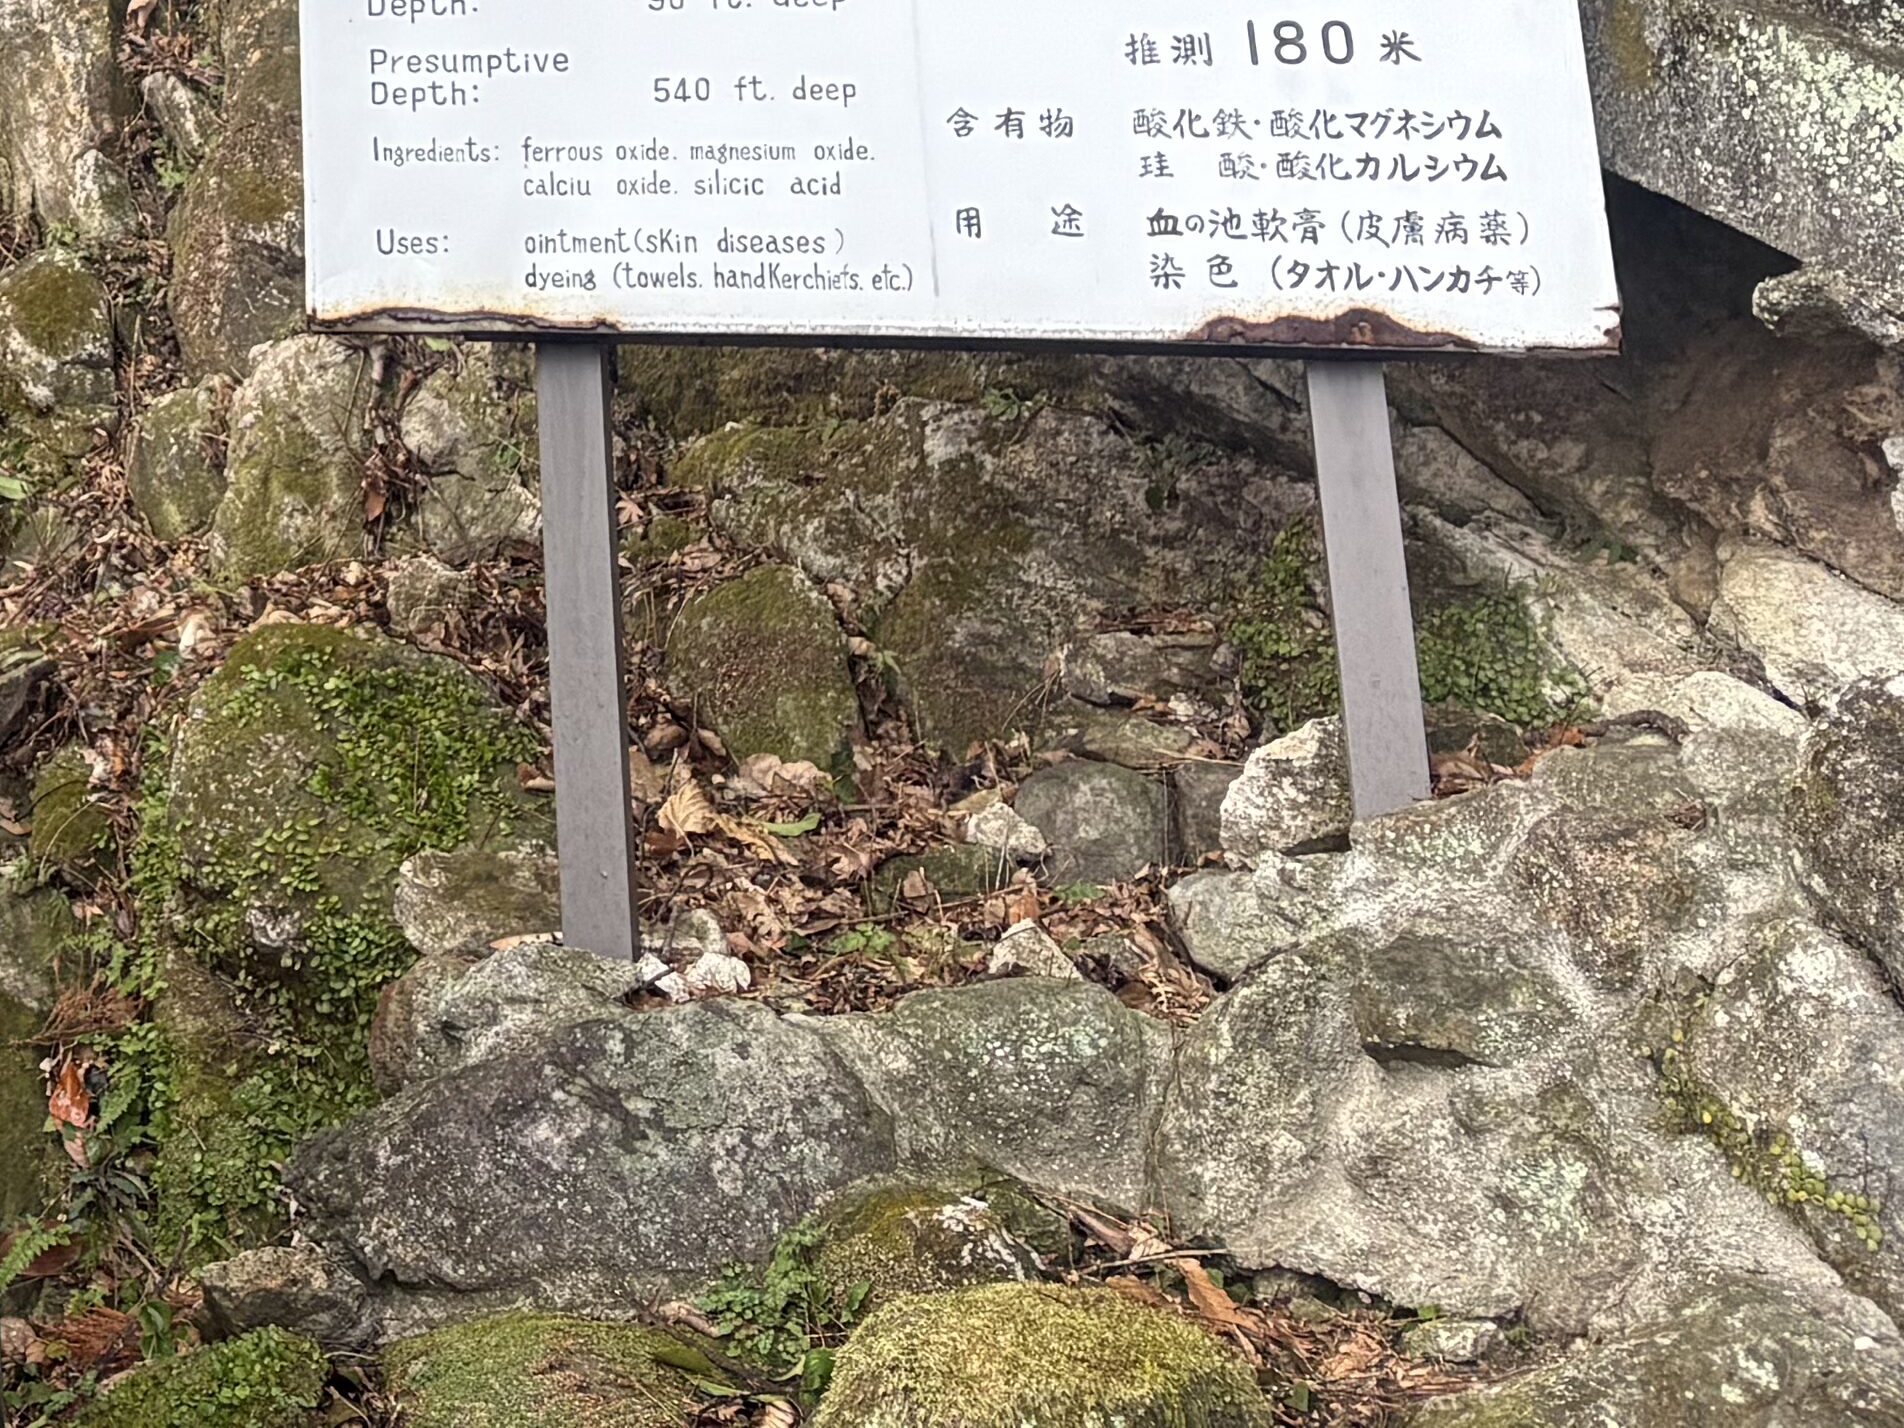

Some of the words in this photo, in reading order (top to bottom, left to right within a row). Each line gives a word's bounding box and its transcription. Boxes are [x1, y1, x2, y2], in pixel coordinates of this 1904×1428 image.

[369, 47, 569, 79] Presumptive
[370, 80, 479, 113] Depth:
[653, 76, 710, 103] 540
[733, 75, 775, 102] ft.
[792, 74, 857, 109] deep
[945, 106, 1074, 140] 含有物
[1132, 107, 1503, 141] 酸化鉄・酸化マグネシウム
[372, 135, 500, 168] Ingredients:
[520, 135, 604, 163] ferrous
[615, 136, 678, 161] oxide.
[689, 143, 796, 165] magnesium
[813, 135, 876, 161] oxide.
[616, 169, 678, 196] oxide.
[693, 167, 765, 197] silicic
[789, 170, 842, 196] acid
[376, 227, 449, 256] Uses:
[524, 262, 597, 292] dyeing
[612, 261, 703, 289] (towels.
[871, 262, 913, 292] etc.)
